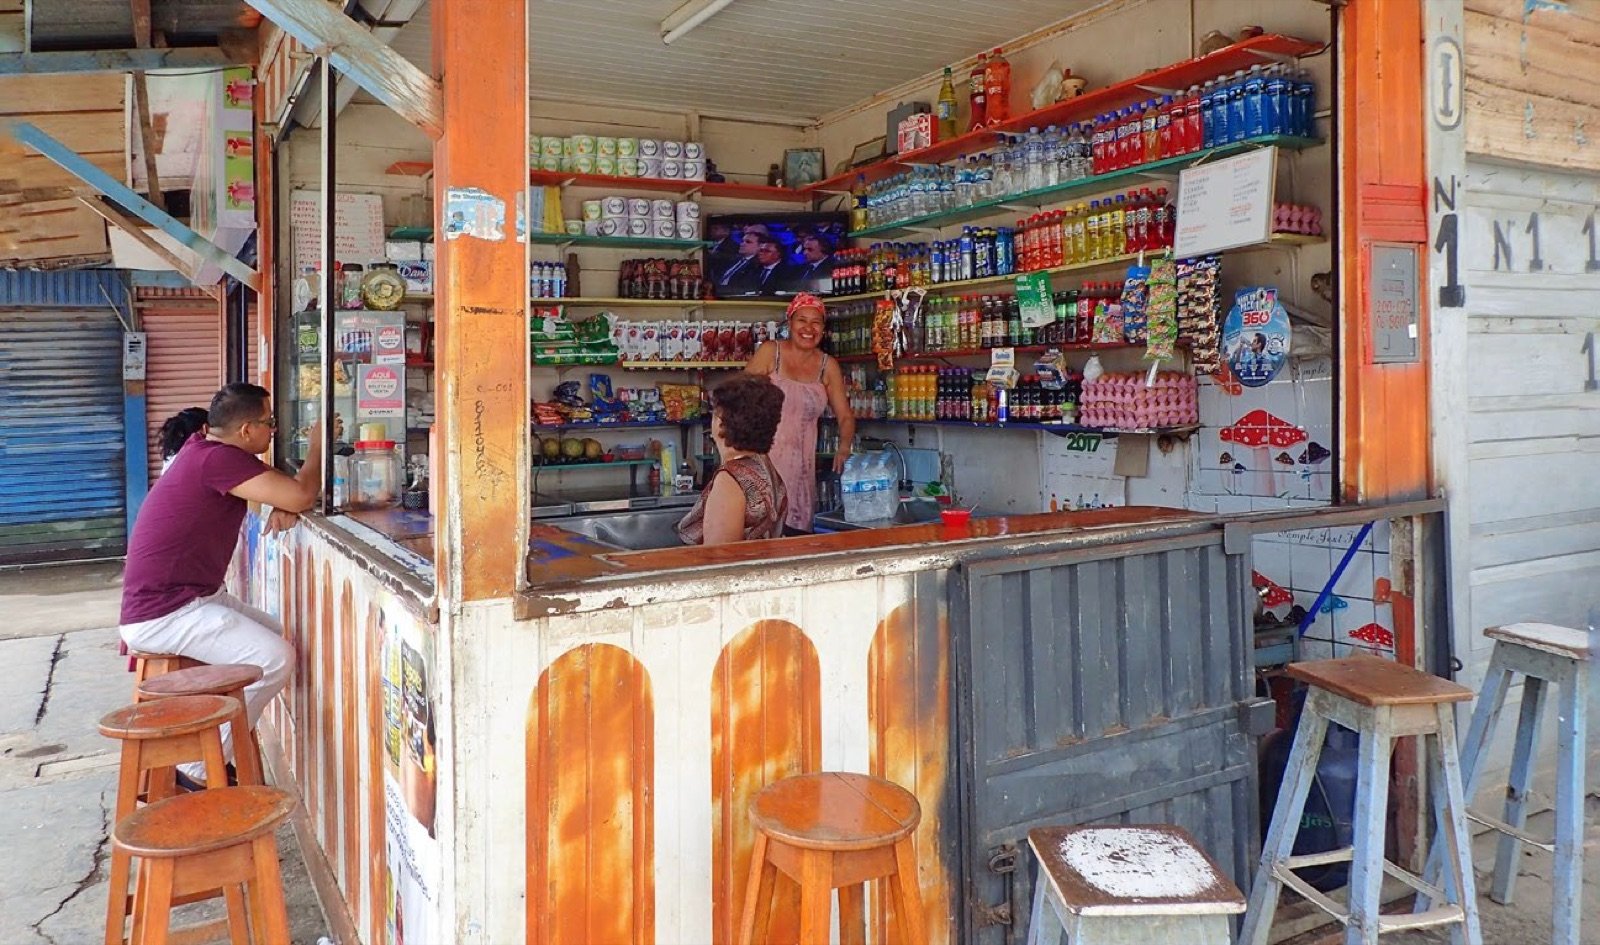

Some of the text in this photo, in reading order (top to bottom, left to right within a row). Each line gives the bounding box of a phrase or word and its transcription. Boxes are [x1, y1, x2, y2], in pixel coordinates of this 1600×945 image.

[1435, 214, 1465, 307] 1
[1243, 311, 1270, 324] 360
[1066, 432, 1102, 452] 2017
